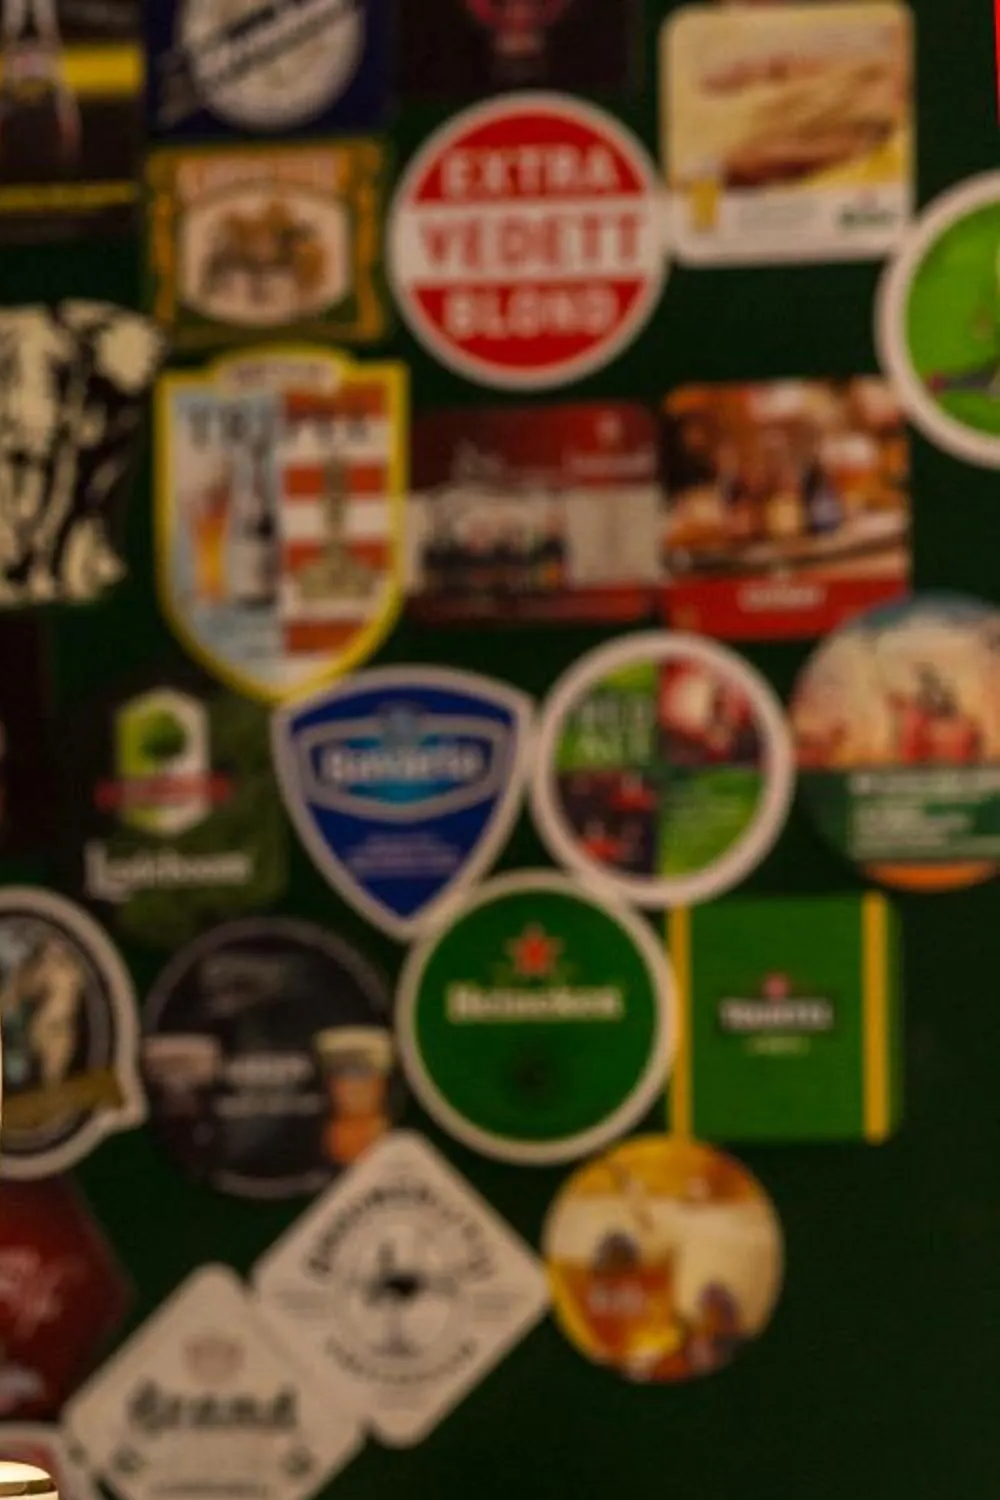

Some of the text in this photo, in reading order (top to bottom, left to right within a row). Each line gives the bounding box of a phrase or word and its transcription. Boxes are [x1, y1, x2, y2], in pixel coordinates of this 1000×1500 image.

[439, 144, 622, 198] EXTRA
[416, 213, 642, 274] VEDETT
[441, 288, 620, 338] BLOND
